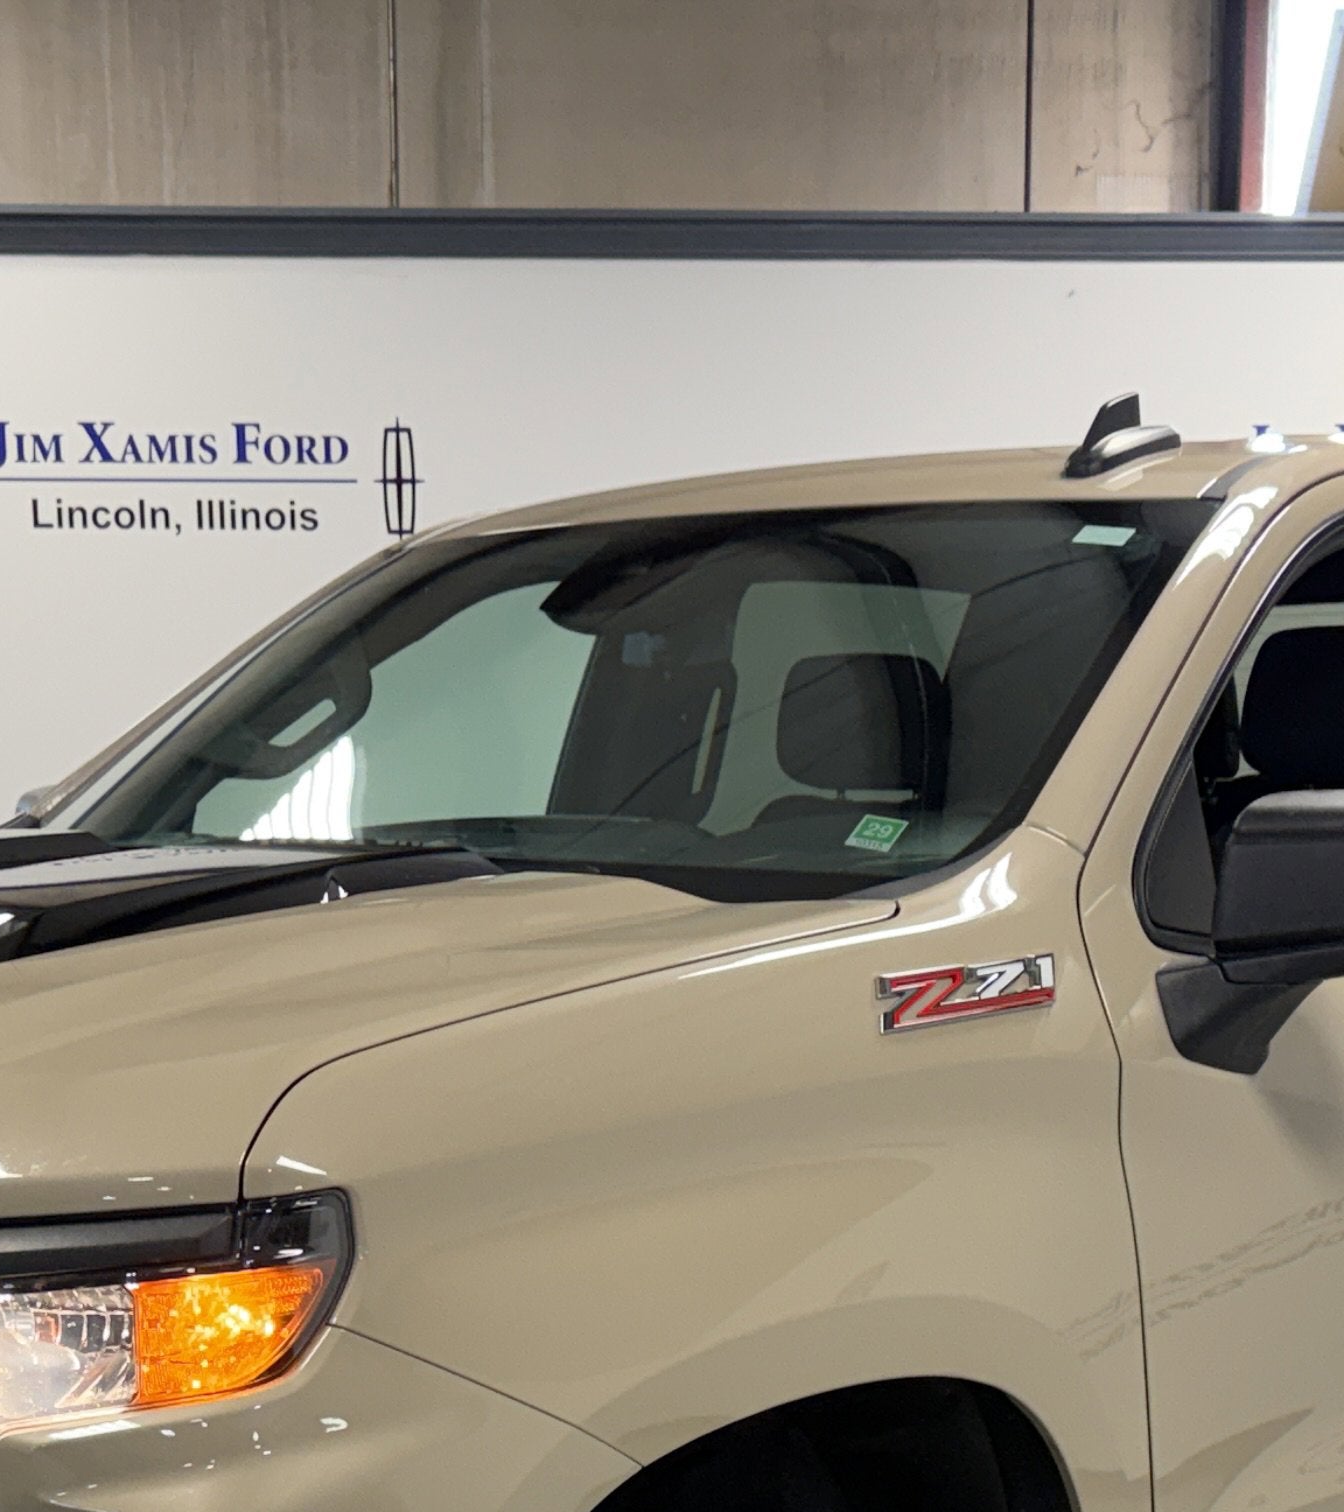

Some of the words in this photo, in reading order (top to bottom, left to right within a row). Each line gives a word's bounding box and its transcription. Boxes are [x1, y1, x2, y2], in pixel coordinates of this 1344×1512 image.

[77, 420, 218, 465] XAMIS
[231, 420, 349, 466] FORD
[32, 498, 182, 536] Lincoln,
[196, 497, 319, 533] Illinois
[862, 821, 894, 839] 29
[875, 952, 1056, 1036] Z71
